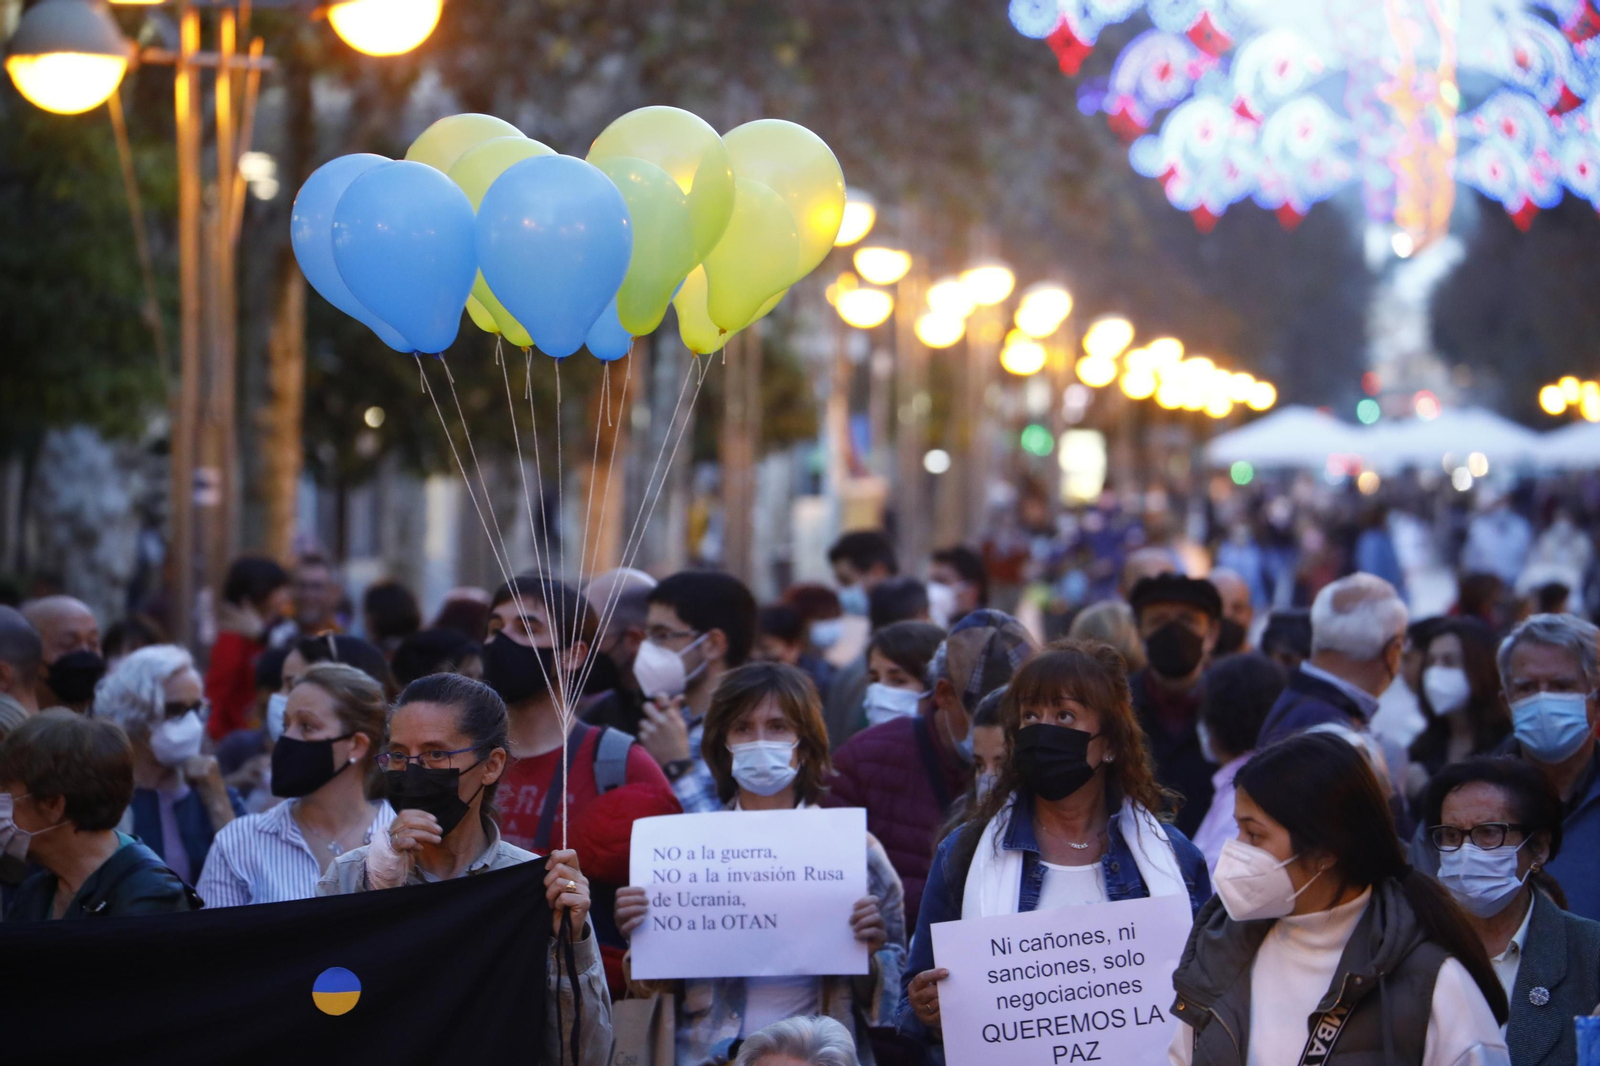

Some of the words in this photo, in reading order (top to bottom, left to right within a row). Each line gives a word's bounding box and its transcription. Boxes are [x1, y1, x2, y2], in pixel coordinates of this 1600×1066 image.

[654, 848, 681, 861] NO
[687, 850, 695, 860] a
[702, 845, 715, 859] la
[720, 847, 777, 863] guerra,
[653, 869, 681, 883] NO
[689, 873, 697, 883] a
[706, 868, 719, 882] la
[727, 864, 796, 882] invasión
[805, 866, 844, 881] Rusa
[652, 891, 671, 907] de
[677, 891, 745, 907] Ucrania,
[654, 916, 682, 930] NO
[687, 920, 696, 930] a
[702, 915, 716, 930] la
[721, 914, 776, 929] OTAN
[991, 937, 1011, 956] Ni
[1019, 930, 1110, 952] cañones,
[1119, 922, 1135, 940] ni
[987, 959, 1097, 983] sanciones,
[1104, 949, 1144, 969] solo
[996, 979, 1142, 1011] negociaciones
[982, 1009, 1127, 1044] QUEREMOS
[1134, 1005, 1165, 1025] LA
[1053, 1041, 1101, 1064] PAZ
